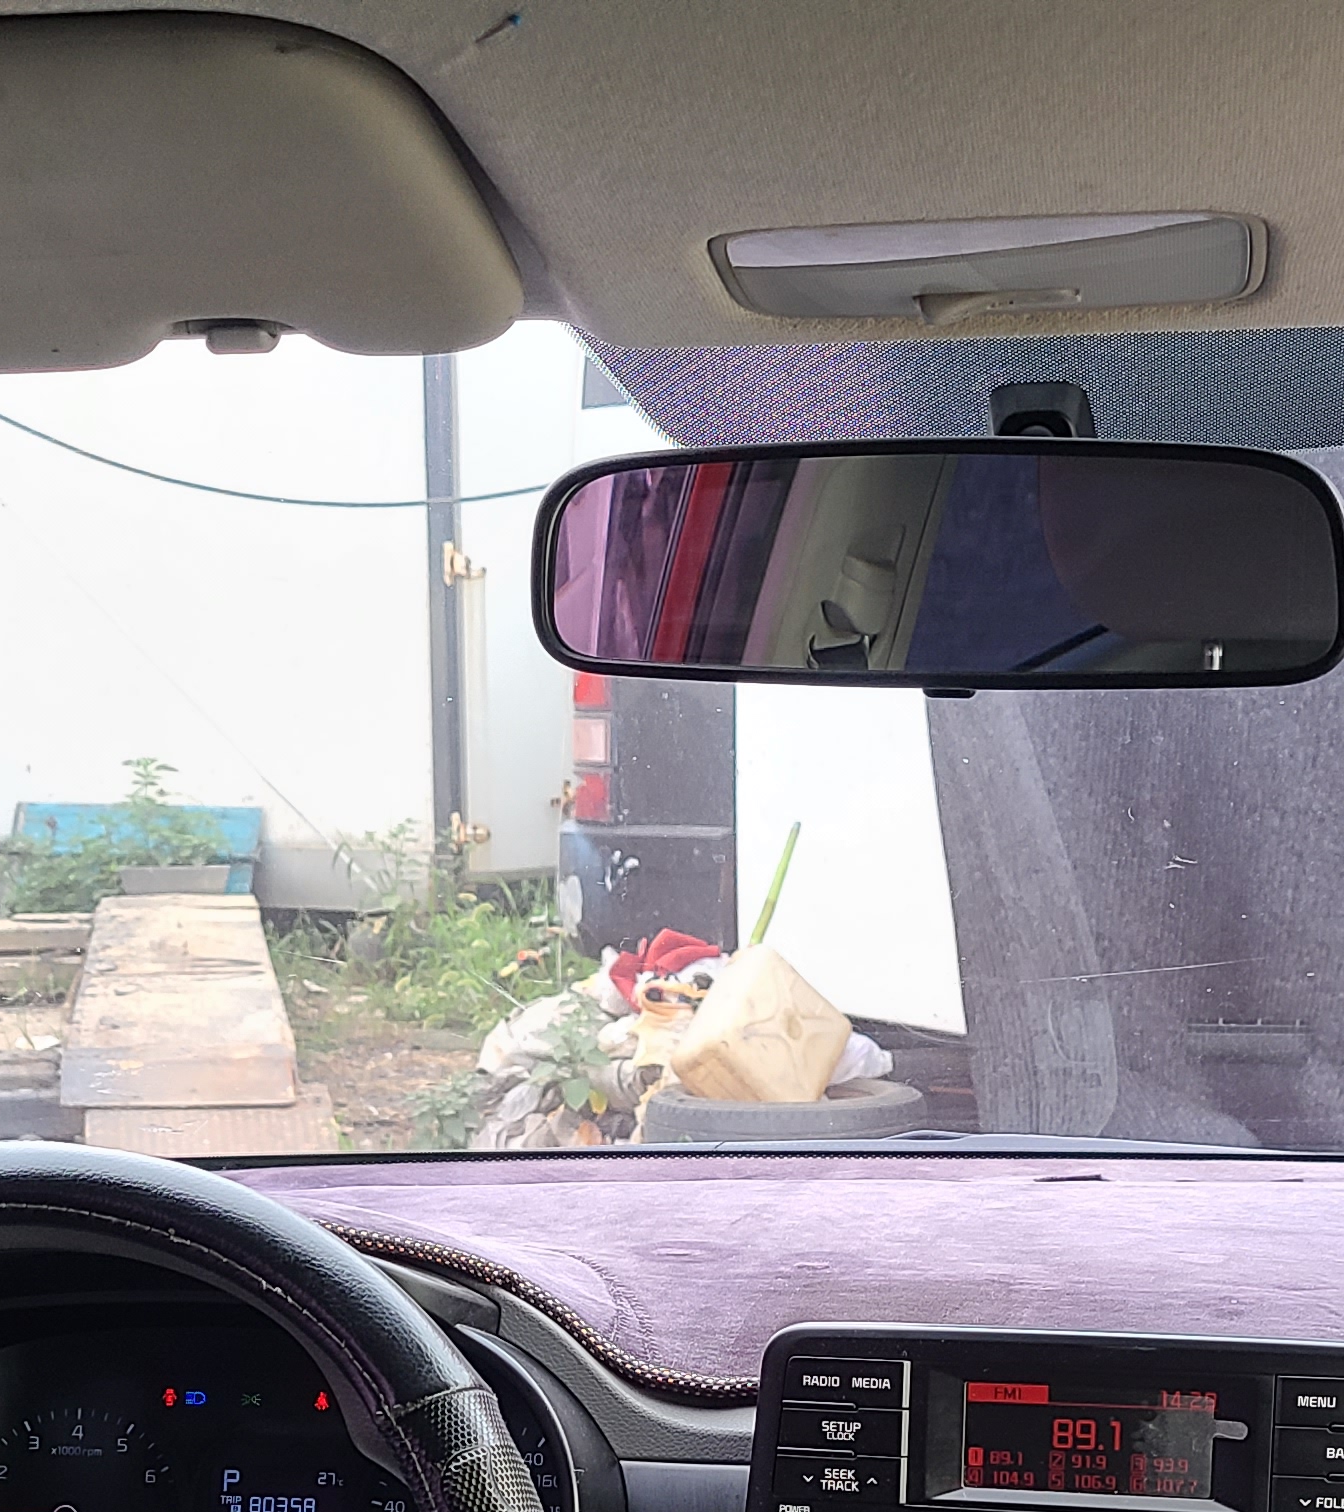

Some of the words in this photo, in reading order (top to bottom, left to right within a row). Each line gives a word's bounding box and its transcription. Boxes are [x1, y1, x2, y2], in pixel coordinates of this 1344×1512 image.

[803, 1375, 840, 1387] RADIO
[852, 1377, 891, 1389] MEDIA
[1297, 1396, 1336, 1408] MENU
[72, 1425, 83, 1440] 4
[822, 1421, 861, 1433] SETUP
[827, 1432, 855, 1441] CLOCK
[1052, 1419, 1121, 1450] 89.1
[29, 1436, 39, 1450] 3
[117, 1438, 127, 1452] 5
[524, 1453, 543, 1466] 40
[990, 1451, 1023, 1466] 89.1
[1072, 1455, 1106, 1469] 91.9
[145, 1470, 155, 1483] 6
[223, 1470, 239, 1491] P
[824, 1468, 855, 1480] SEEK
[993, 1472, 1034, 1486] 104.9
[1075, 1475, 1116, 1489] 106.9
[820, 1480, 859, 1492] TRACK
[221, 1495, 242, 1504] TRIP
